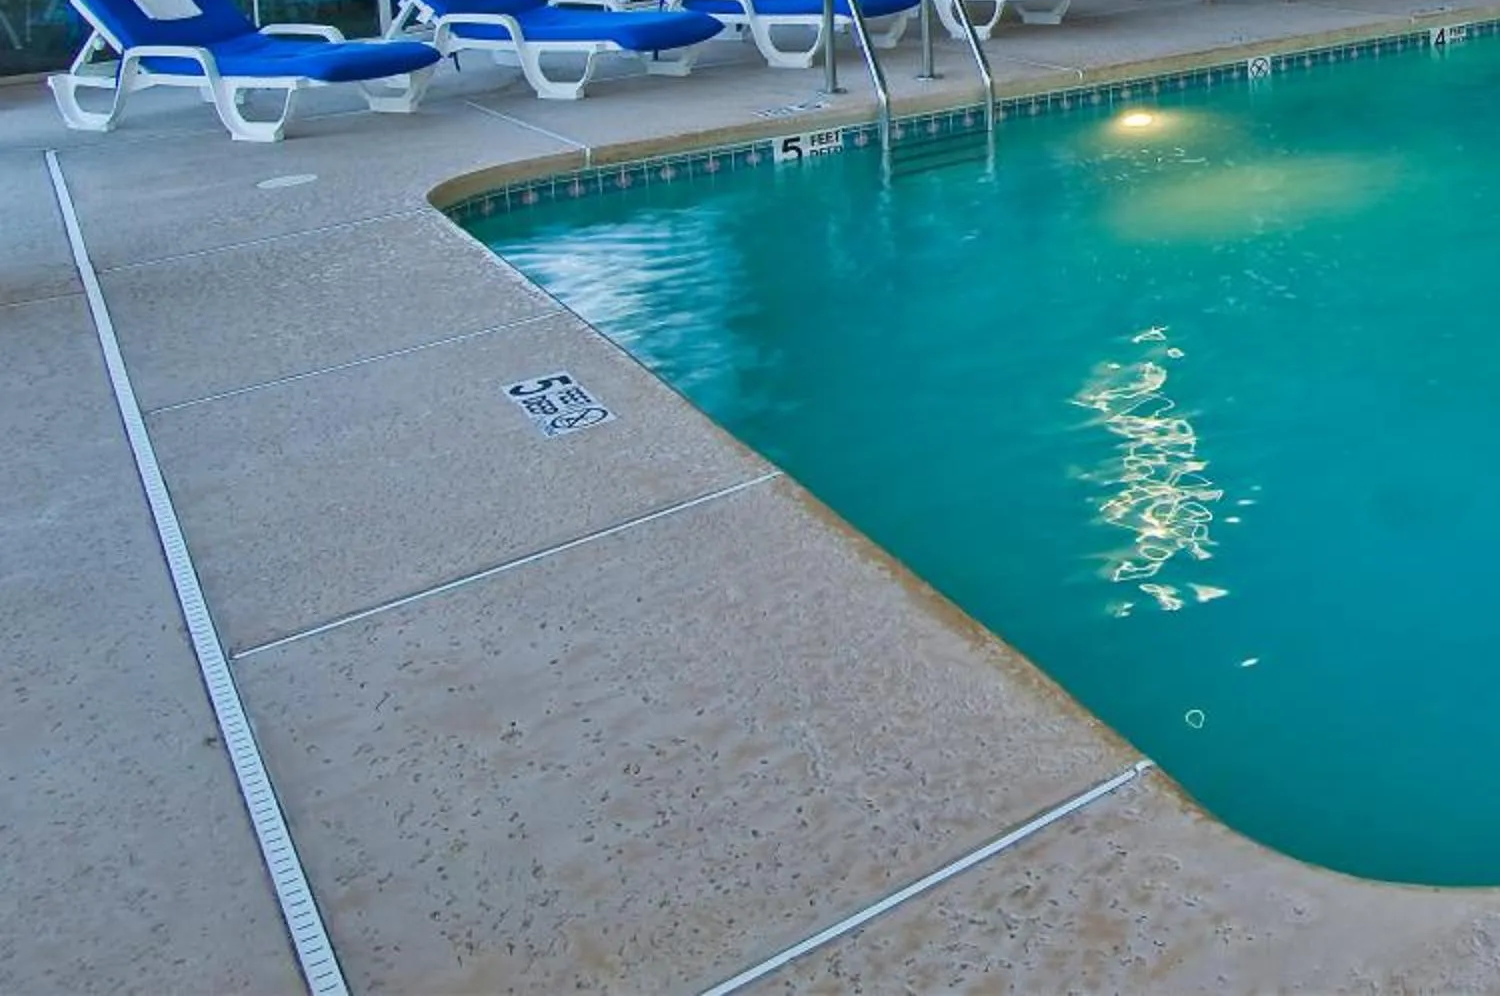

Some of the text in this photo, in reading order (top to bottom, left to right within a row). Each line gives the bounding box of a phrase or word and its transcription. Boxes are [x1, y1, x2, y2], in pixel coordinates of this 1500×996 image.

[1434, 27, 1446, 45] 4
[809, 130, 840, 147] FEET
[782, 136, 803, 161] 5
[509, 375, 572, 396] 5
